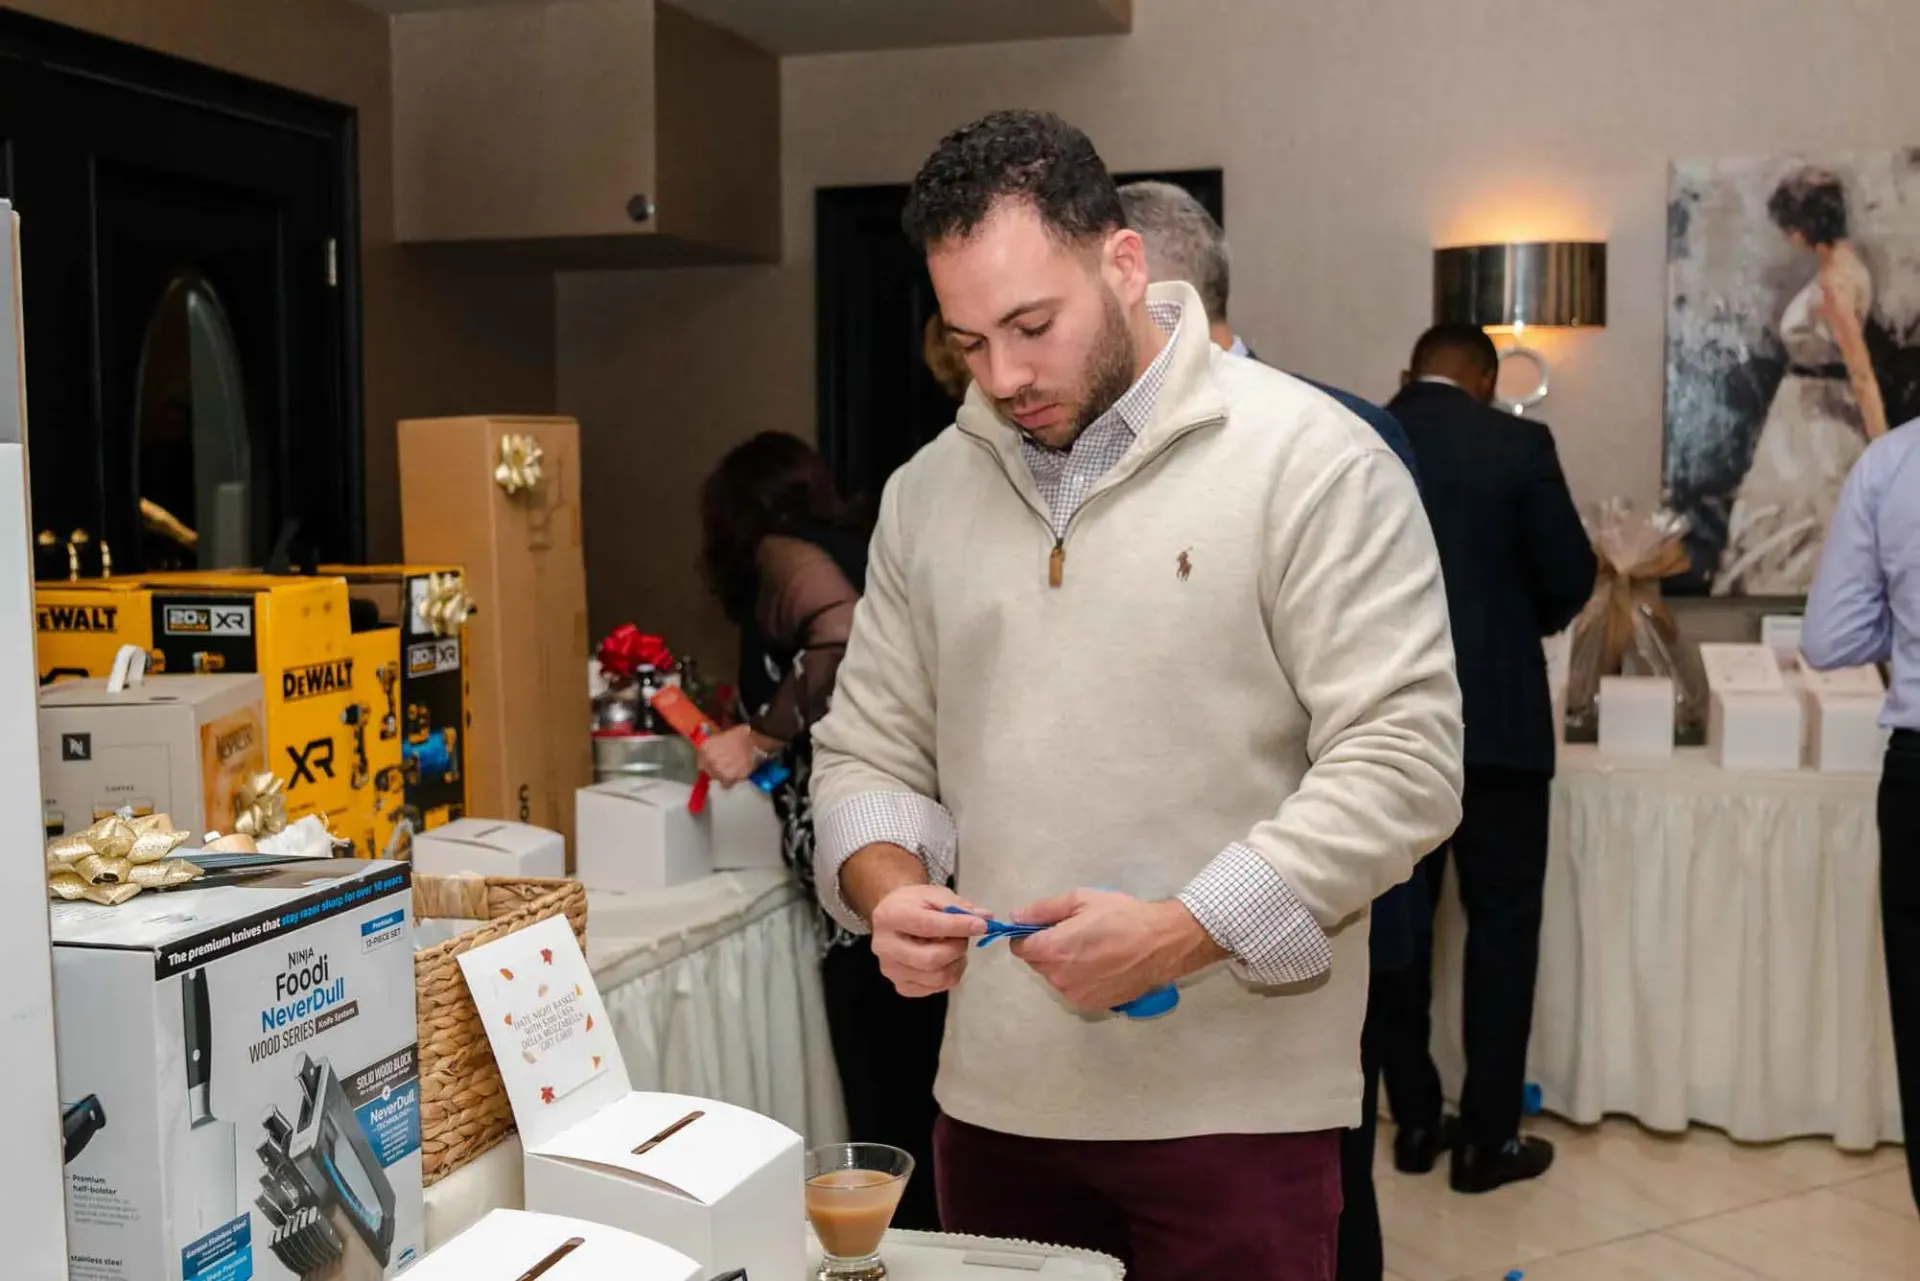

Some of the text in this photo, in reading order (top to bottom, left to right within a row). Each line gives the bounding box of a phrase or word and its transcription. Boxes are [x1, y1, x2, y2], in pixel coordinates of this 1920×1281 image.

[37, 607, 117, 630] EWALT
[215, 612, 244, 629] XR
[286, 737, 335, 790] XR
[168, 875, 403, 966] The premium knives that stay razor sharp for over 10 years
[390, 927, 401, 938] SET
[276, 953, 328, 1001] Foodi
[288, 947, 314, 969] NINJA
[262, 977, 344, 1033] NeverDull
[249, 1007, 355, 1064] WOOD SERIES Knife System
[356, 1070, 375, 1090] SOLID
[374, 1061, 393, 1079] WOOD
[393, 1050, 412, 1068] BLOCK
[370, 1089, 415, 1126] NeverDull
[72, 1174, 106, 1184] Premium
